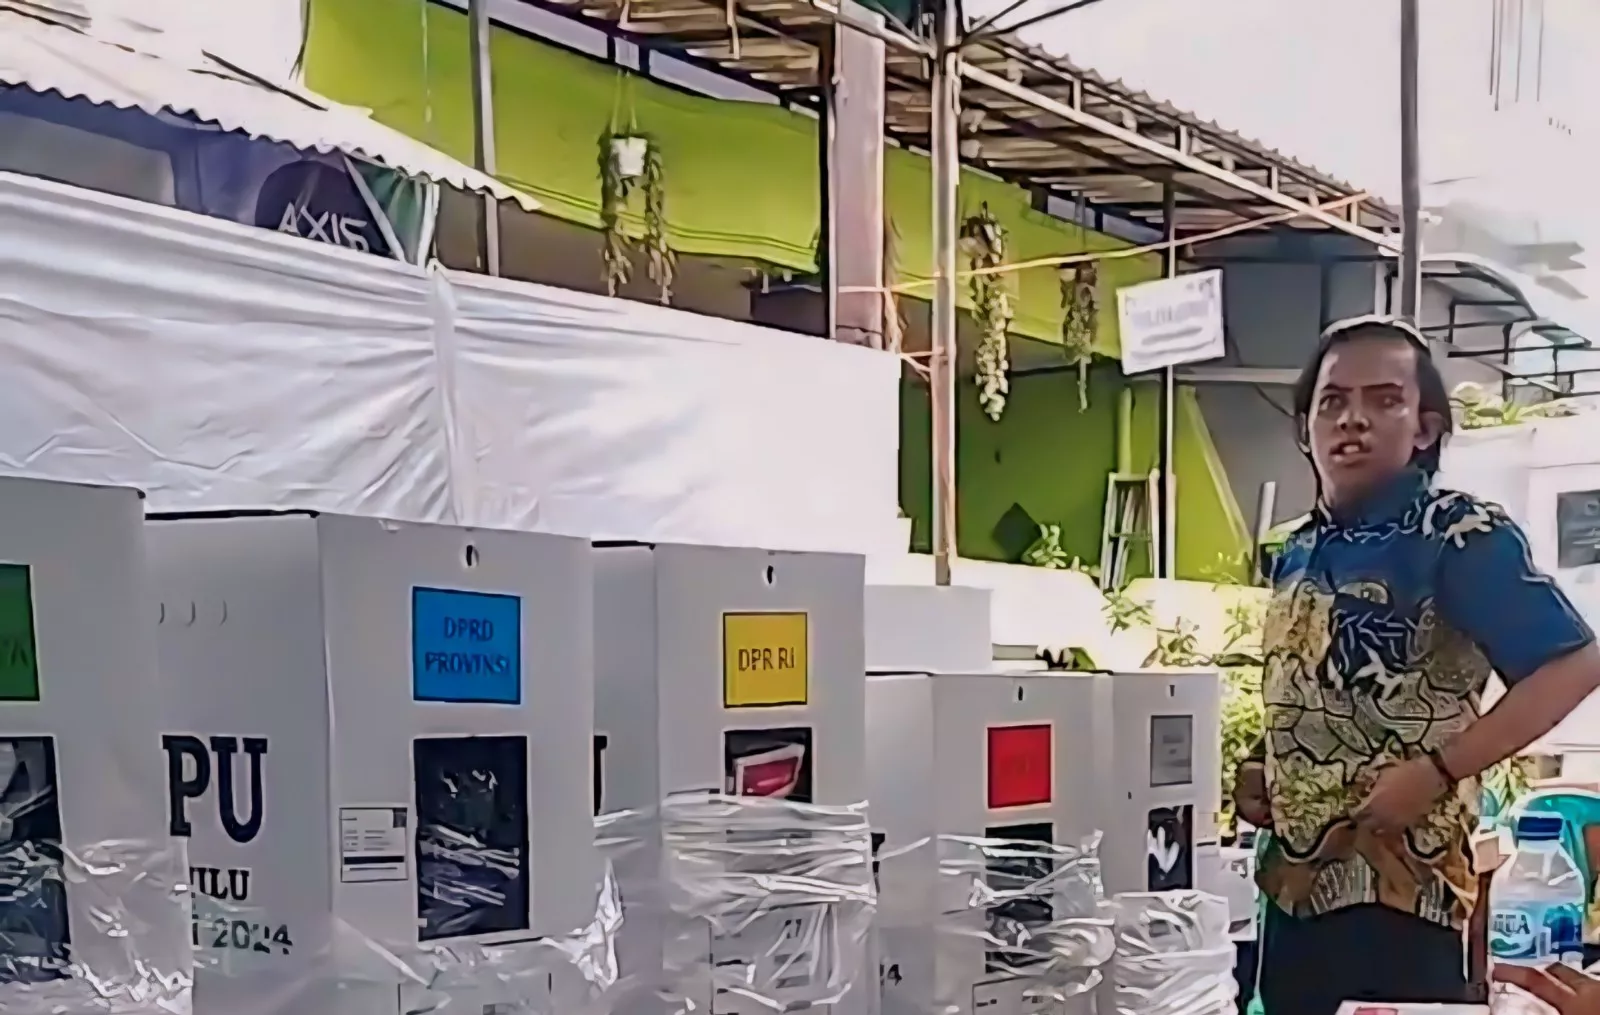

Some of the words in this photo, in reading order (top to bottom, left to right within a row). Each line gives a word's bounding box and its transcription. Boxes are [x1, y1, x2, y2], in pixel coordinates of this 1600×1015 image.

[277, 202, 370, 253] AXIS
[443, 616, 494, 642] DPRD
[738, 647, 774, 671] DPR
[778, 646, 795, 670] RI
[162, 734, 268, 844] PU
